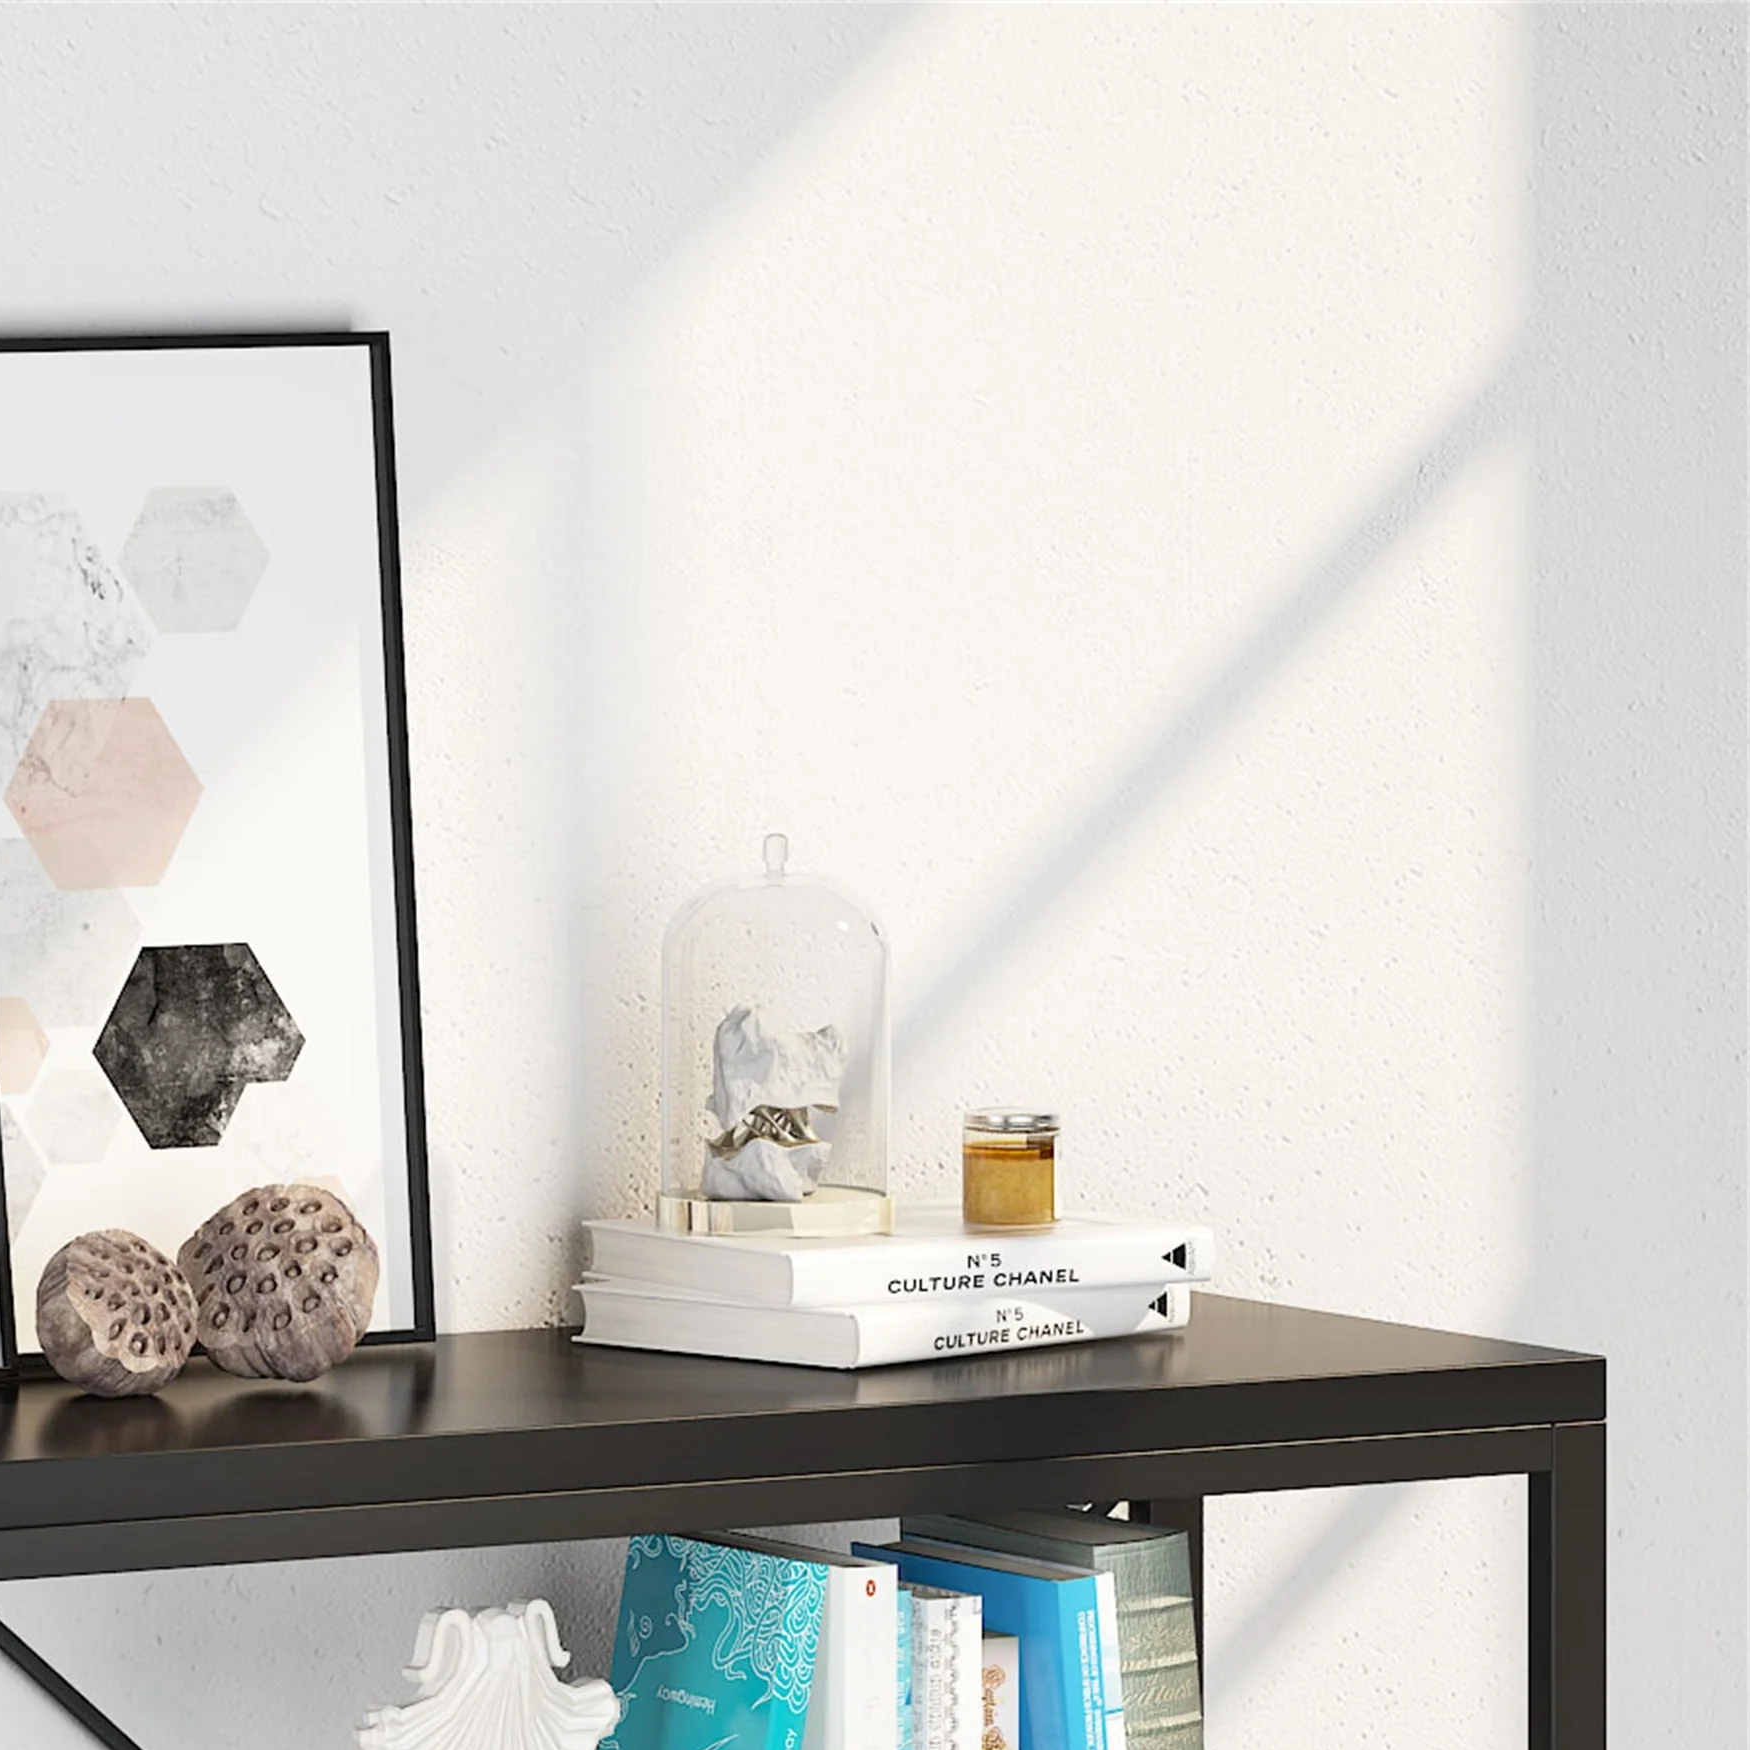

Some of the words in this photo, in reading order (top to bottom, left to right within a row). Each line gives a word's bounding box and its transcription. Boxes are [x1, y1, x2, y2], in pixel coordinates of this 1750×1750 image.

[887, 1274, 985, 1294] CULTURE
[993, 1268, 1080, 1287] CHANEL
[933, 1328, 1010, 1351] CULTURE
[1016, 1320, 1084, 1341] CHANEL
[656, 1684, 717, 1716] Hemingway
